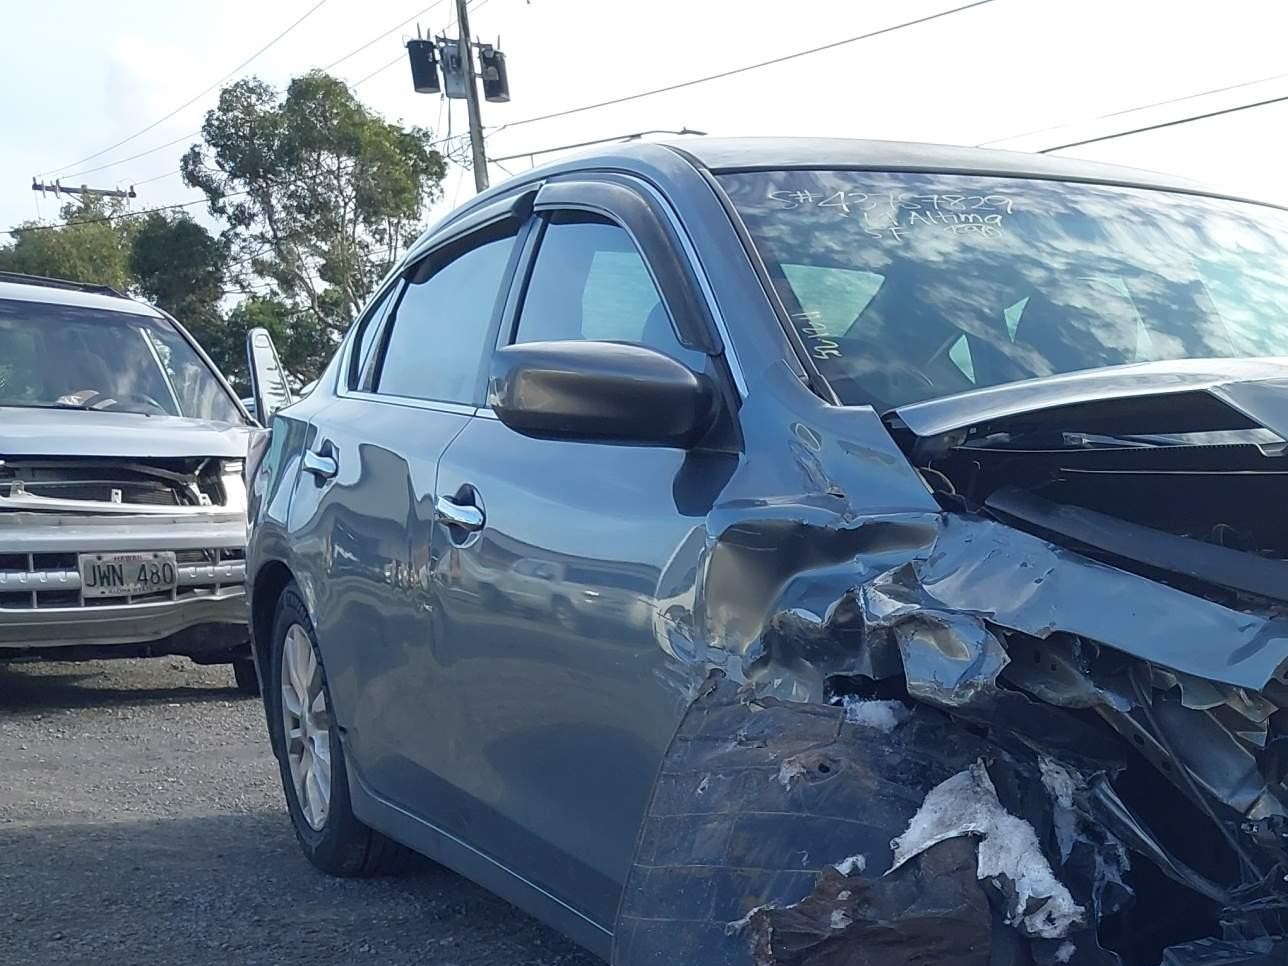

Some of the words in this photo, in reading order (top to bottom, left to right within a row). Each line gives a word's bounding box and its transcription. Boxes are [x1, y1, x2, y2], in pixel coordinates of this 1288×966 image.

[908, 211, 1003, 226] Altima
[86, 564, 125, 587] JWN
[137, 562, 174, 585] 480
